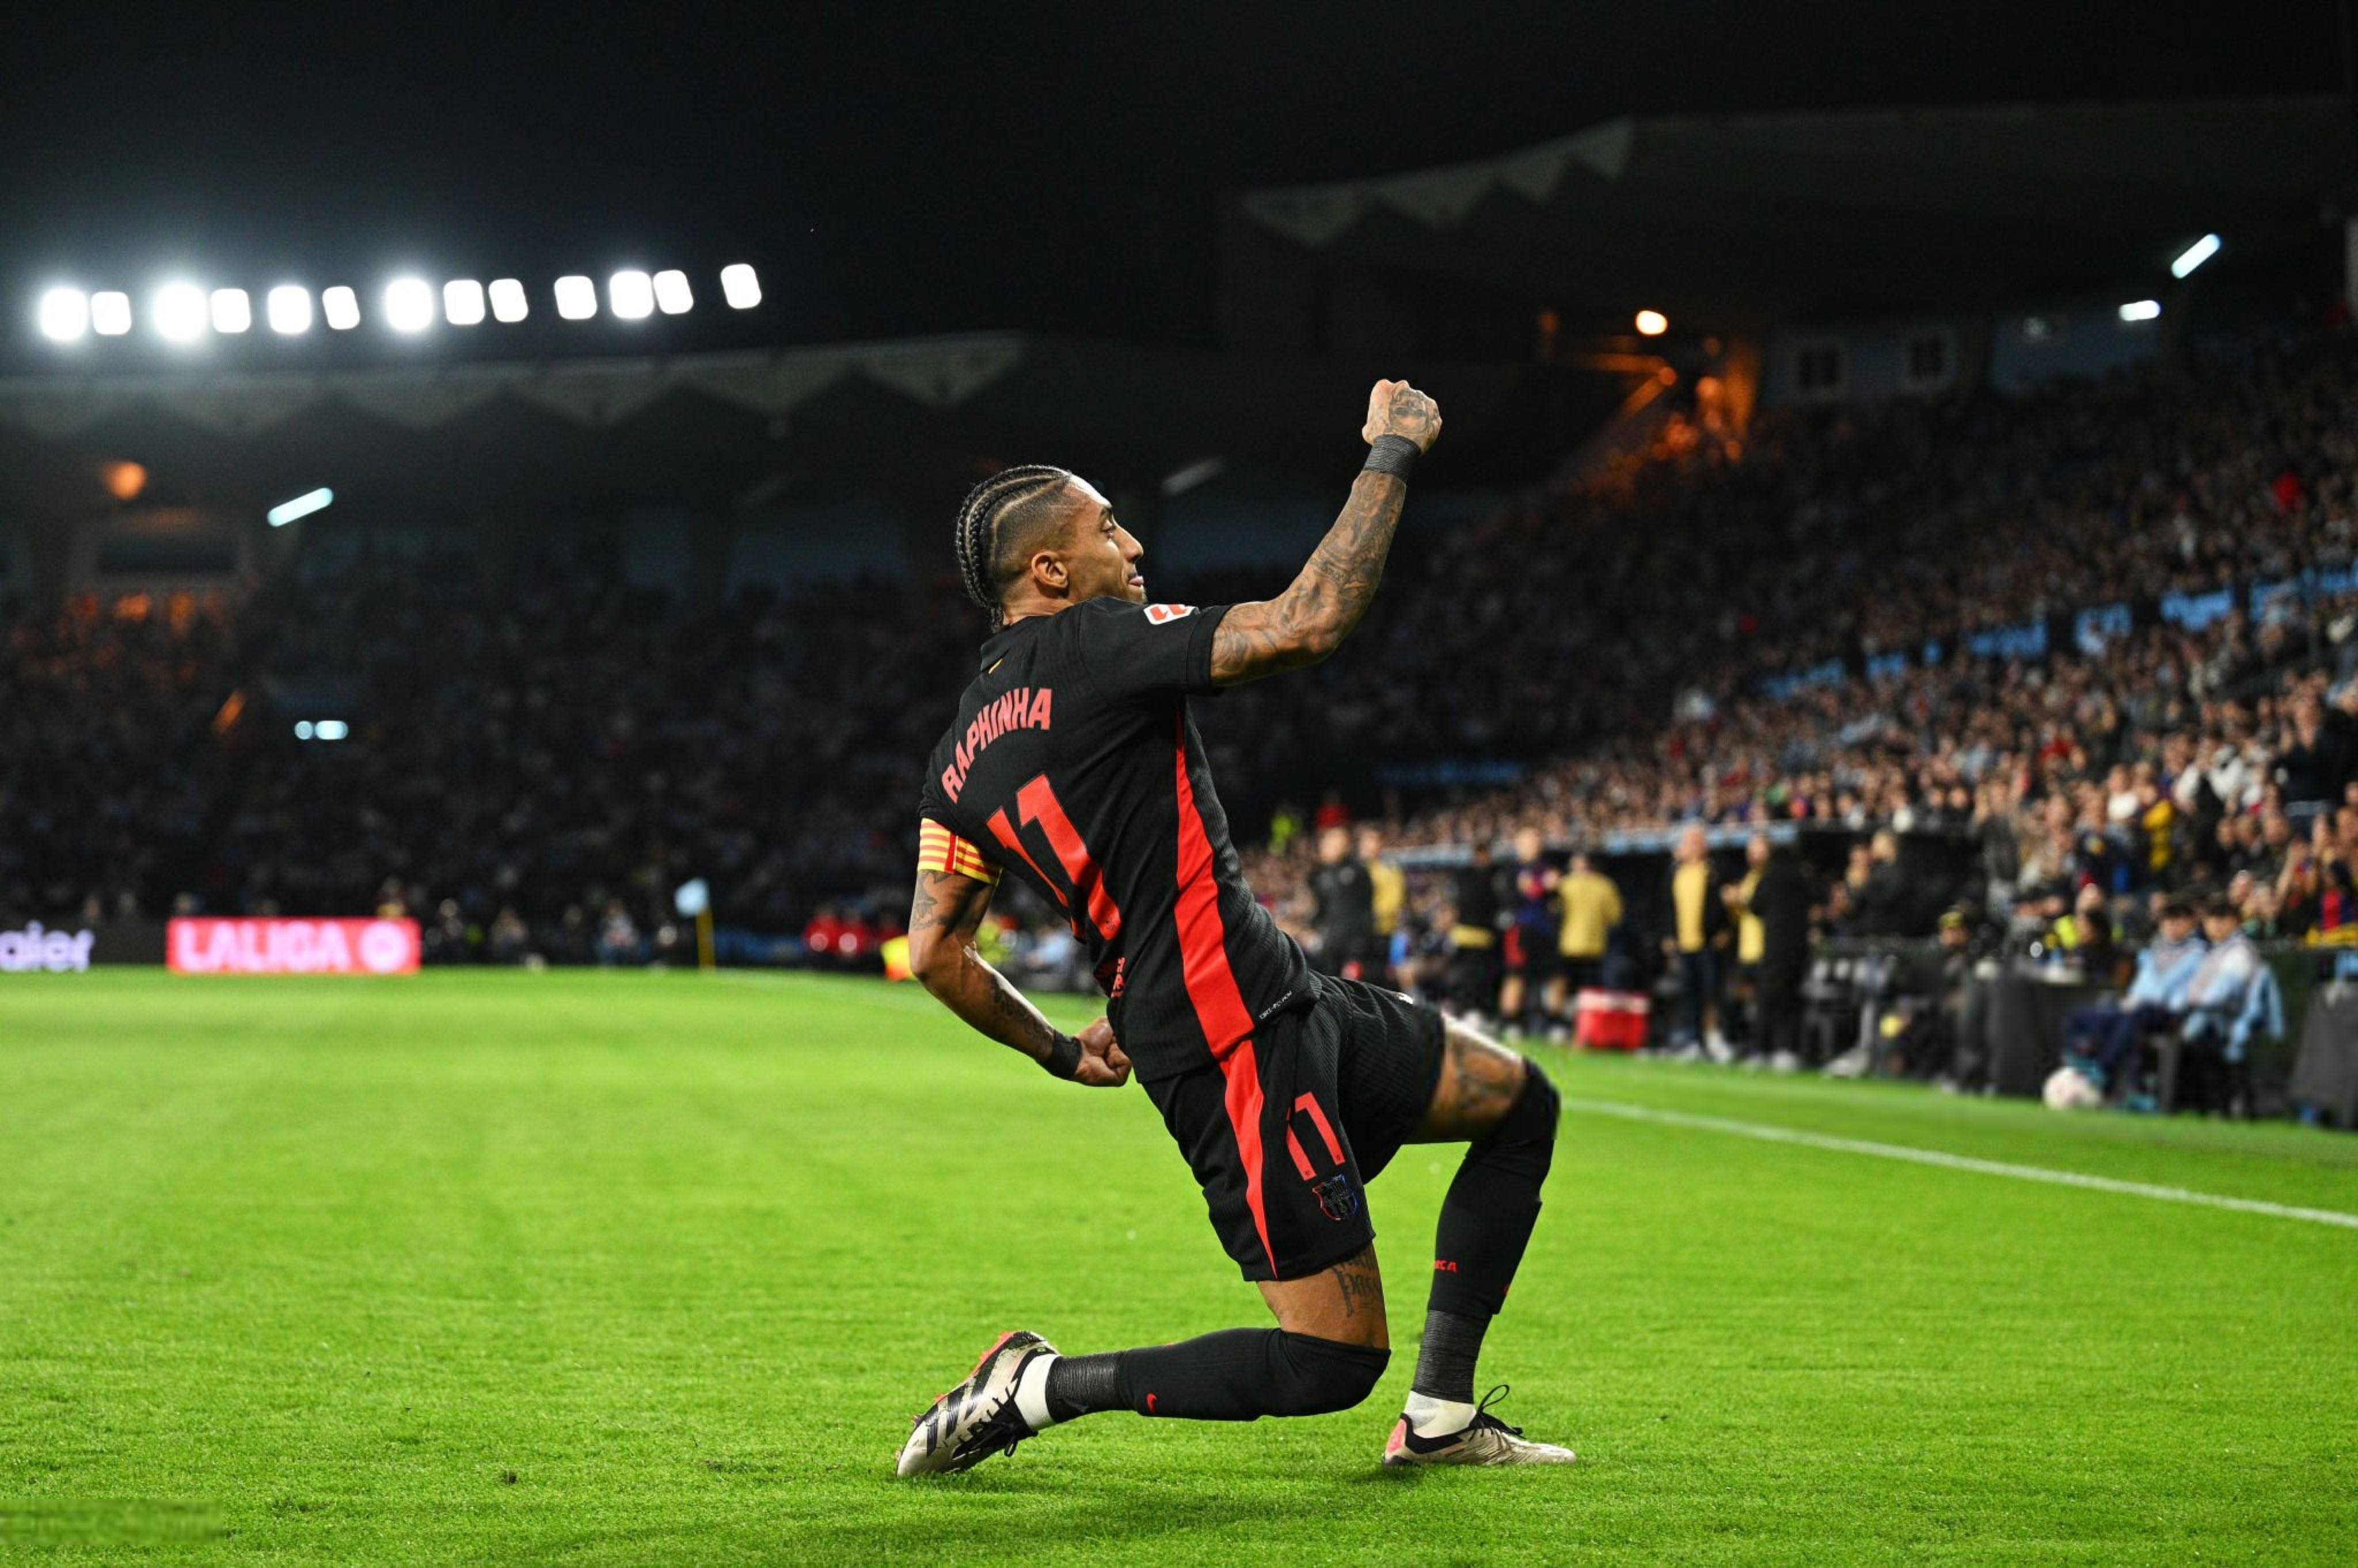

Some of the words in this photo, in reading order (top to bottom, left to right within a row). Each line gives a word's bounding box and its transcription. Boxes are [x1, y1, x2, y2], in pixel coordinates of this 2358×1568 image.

[942, 687, 1052, 804] RAPHINHA
[986, 773, 1121, 941] 11
[176, 921, 352, 972] LALIGA
[1286, 1091, 1345, 1181] 11
